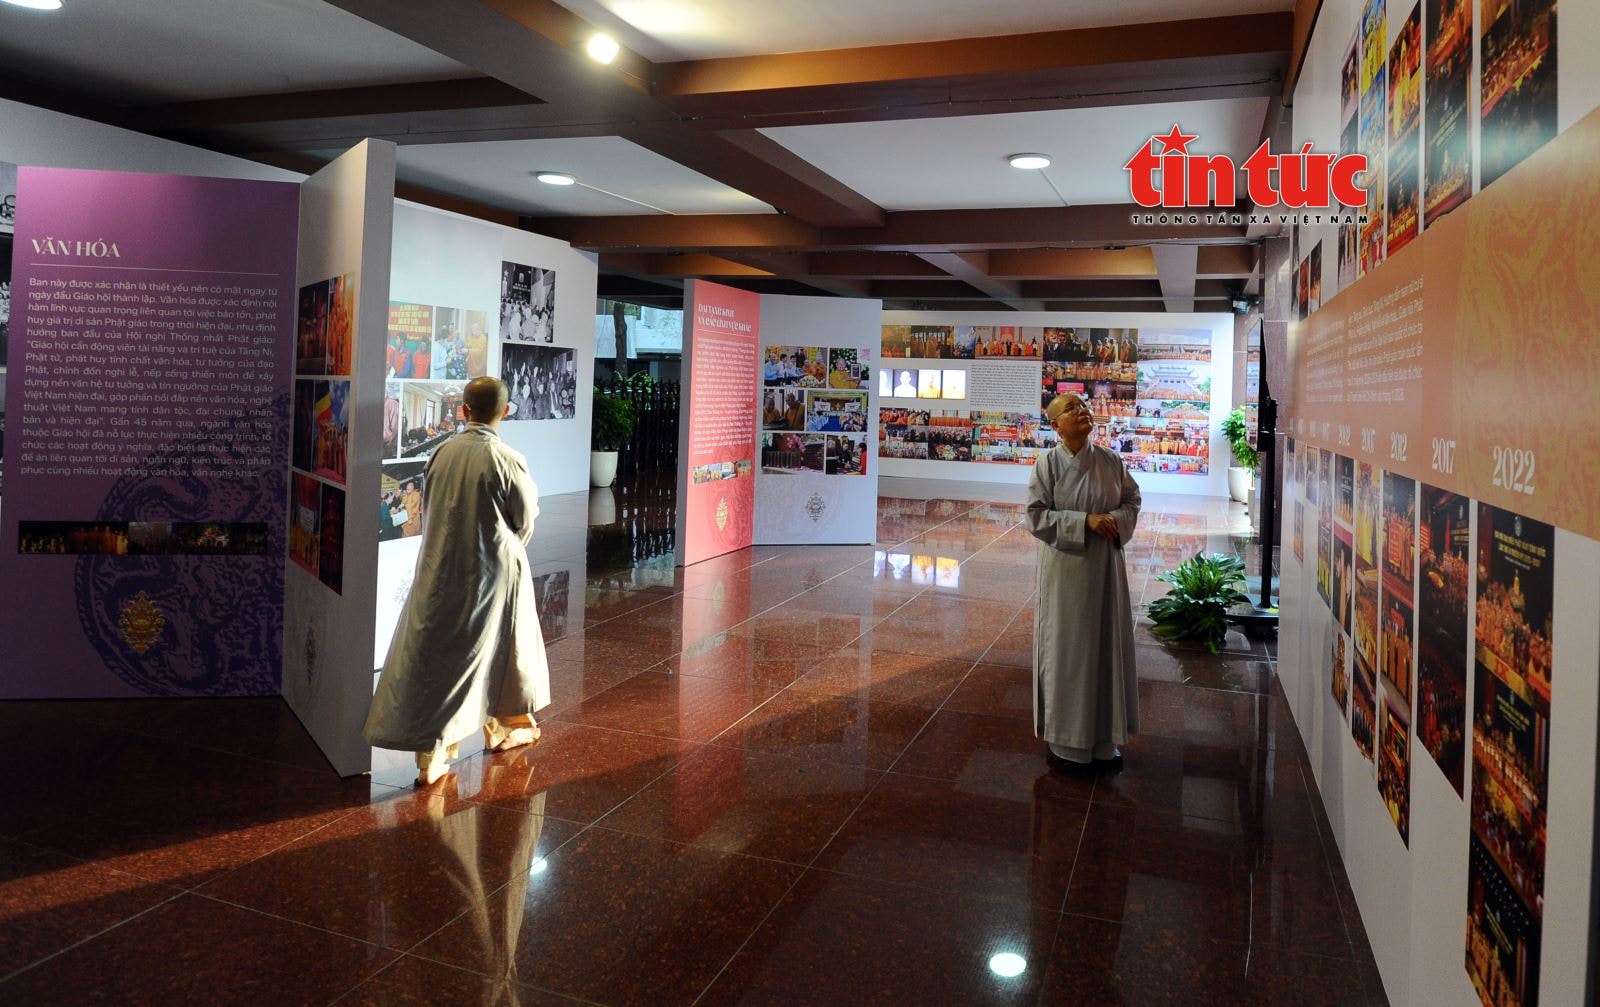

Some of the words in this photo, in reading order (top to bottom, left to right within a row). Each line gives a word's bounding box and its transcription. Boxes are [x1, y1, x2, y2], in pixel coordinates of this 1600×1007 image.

[32, 236, 72, 256] VĂN
[76, 238, 120, 258] HÓA
[29, 278, 48, 286] Ban
[87, 306, 111, 315] quan
[113, 305, 138, 316] trọng
[157, 309, 181, 318] quan
[27, 315, 44, 326] huy
[62, 316, 72, 326] trị
[74, 316, 83, 325] di
[149, 319, 174, 330] trong
[60, 329, 78, 337] ban
[145, 331, 165, 342] nghị
[89, 354, 106, 365] huy
[104, 367, 125, 378] nghi
[1390, 432, 1408, 462] 2012
[1432, 438, 1456, 474] 2017
[1492, 445, 1536, 496] 2022
